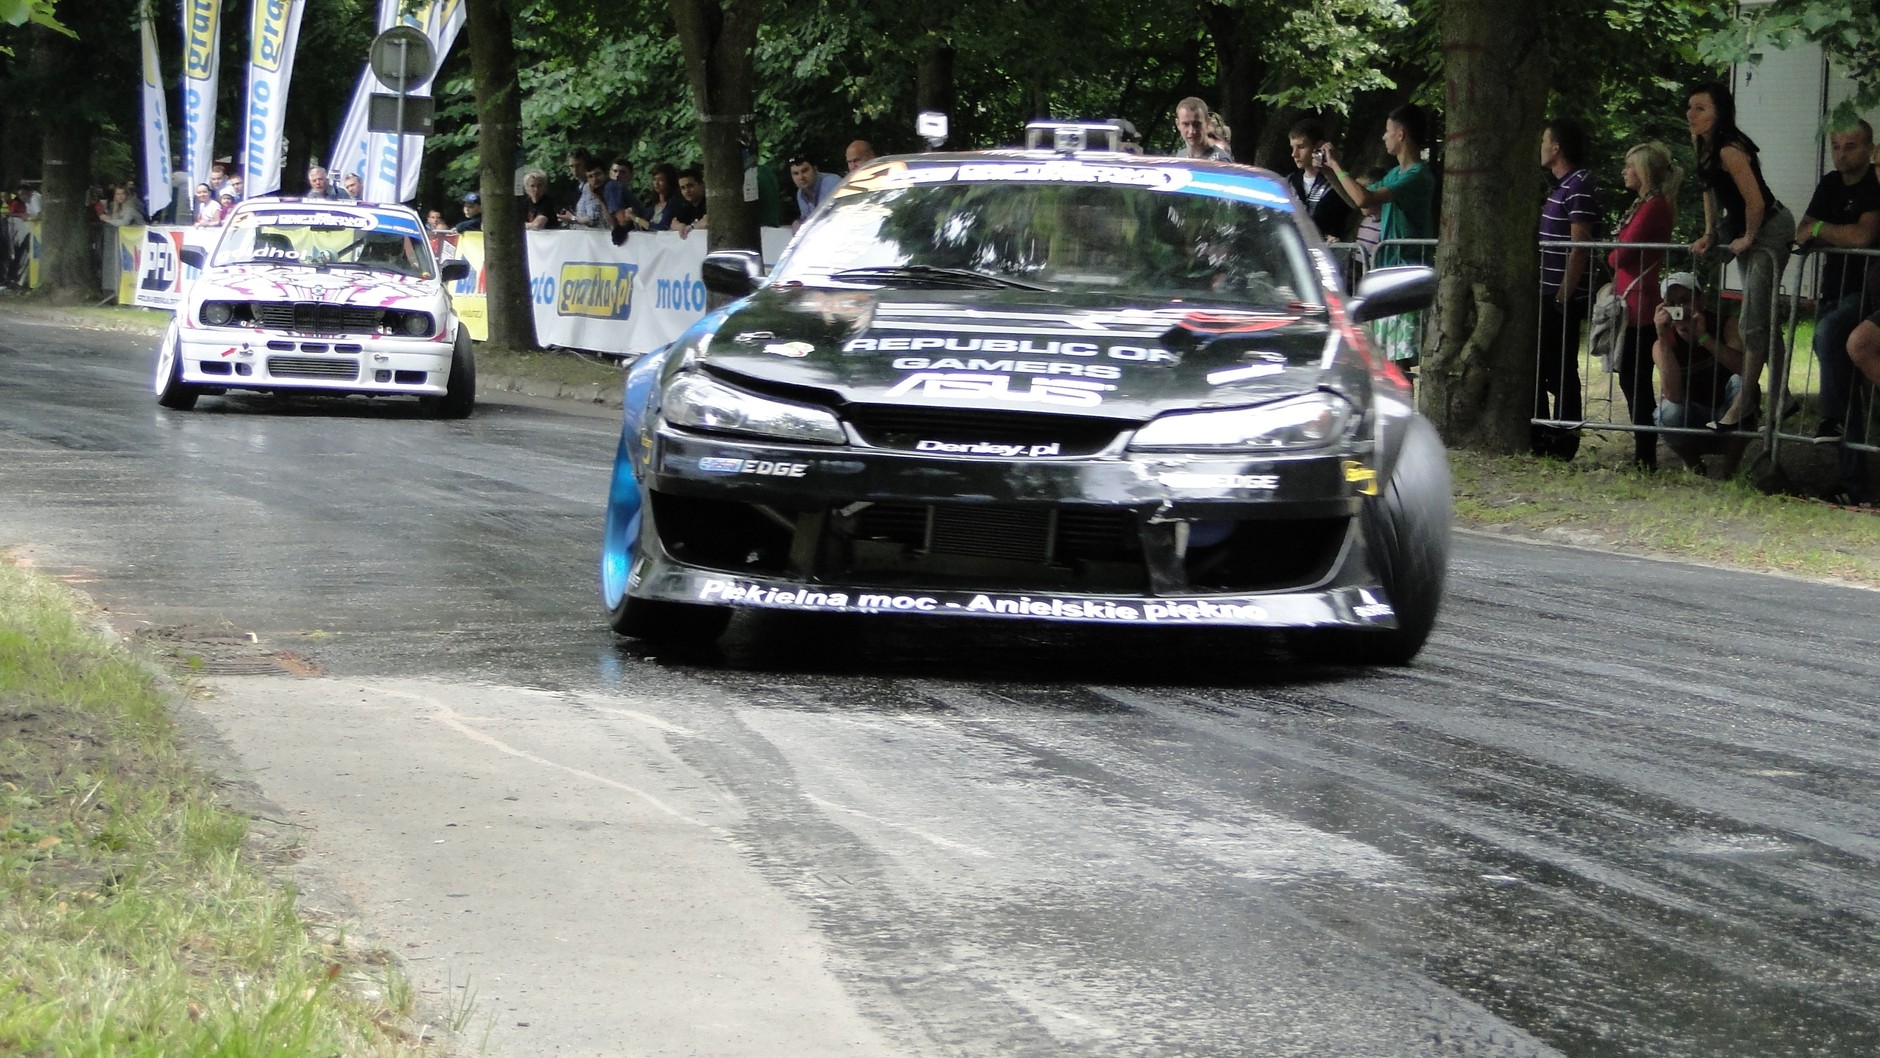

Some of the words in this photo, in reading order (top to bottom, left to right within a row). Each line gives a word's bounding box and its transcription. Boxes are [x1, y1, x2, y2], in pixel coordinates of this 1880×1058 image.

[250, 80, 271, 177] moto
[531, 272, 556, 304] oto
[562, 269, 635, 313] gratka.pl
[655, 273, 706, 312] moto
[842, 338, 1099, 357] REPUBLIC
[892, 358, 1121, 379] GAMERS
[883, 373, 1103, 407] ASUS
[916, 440, 1061, 457] Denley.pl
[741, 460, 809, 477] EDGE
[699, 580, 849, 607] Piekielna
[858, 594, 938, 610] moc
[965, 594, 1139, 619] Anielskie
[1143, 600, 1268, 622] piękno
